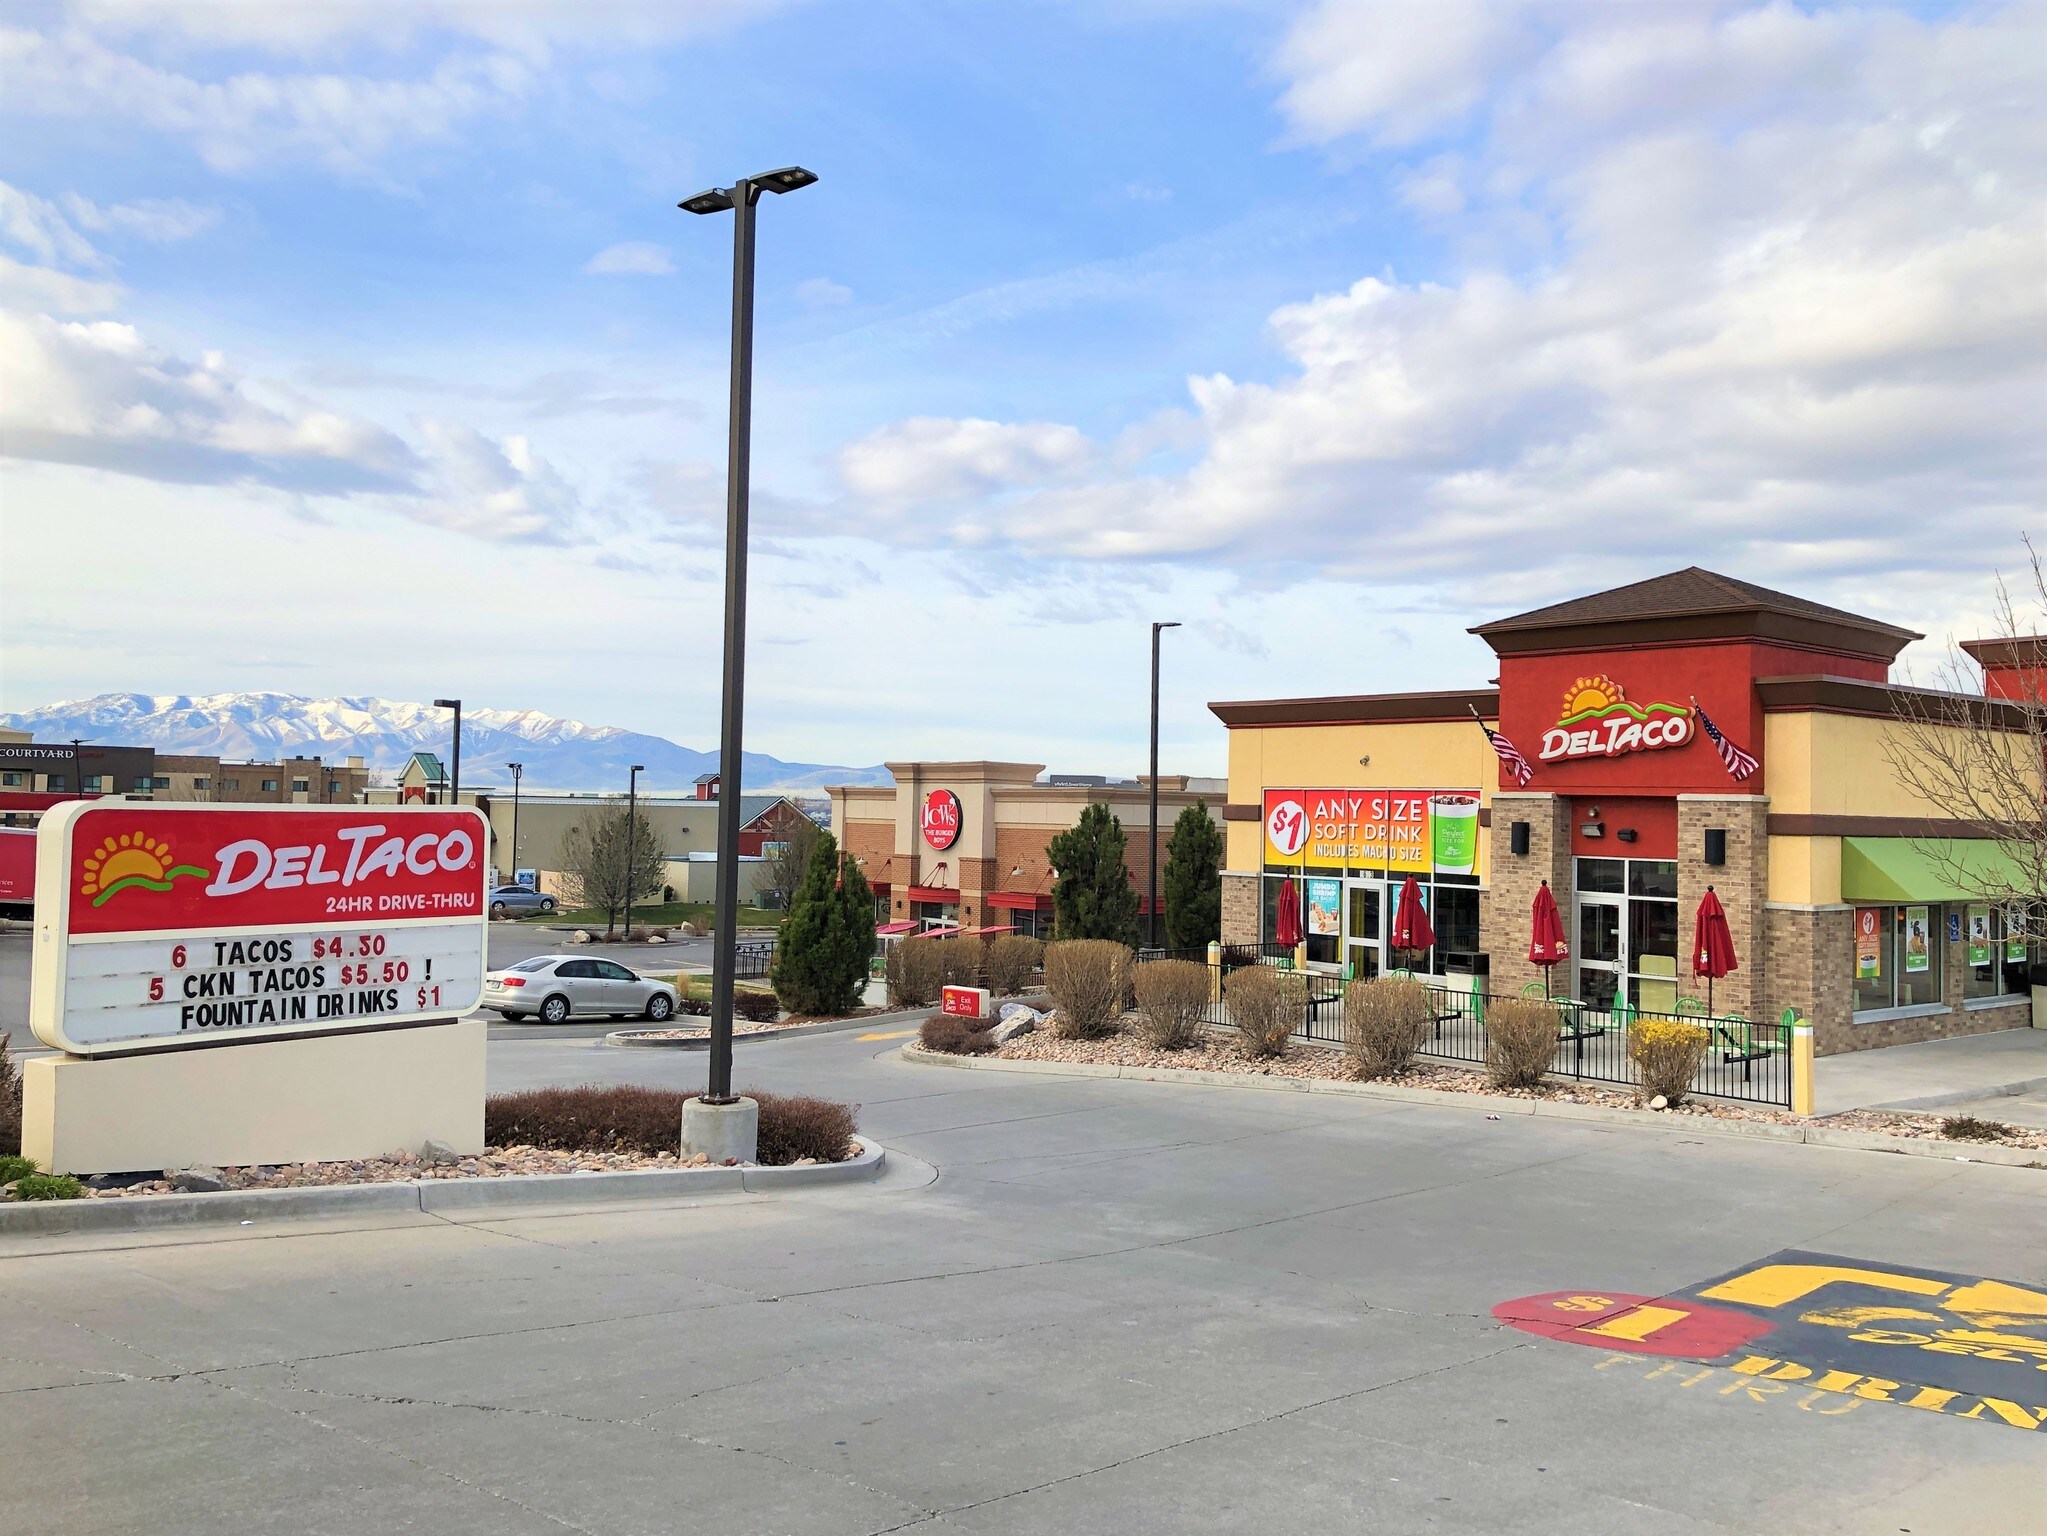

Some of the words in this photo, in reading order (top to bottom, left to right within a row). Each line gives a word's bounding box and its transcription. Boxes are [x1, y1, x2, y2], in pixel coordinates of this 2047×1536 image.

[1539, 729, 1606, 759] DEL
[1603, 717, 1687, 753] TACO
[0, 748, 74, 759] COURTYARD
[1314, 798, 1363, 820] ANY
[1371, 799, 1424, 822] SIZE
[1273, 807, 1303, 850] $1
[1314, 823, 1359, 840] SOFT
[1364, 824, 1424, 843] DRINK
[205, 839, 340, 898] DEL
[337, 824, 474, 888] TACO
[1400, 847, 1423, 862] SIZE
[1312, 882, 1336, 890] JUMBO
[1312, 889, 1336, 897] SHRIMP
[325, 896, 374, 913] 24HR
[378, 892, 476, 911] DRIVE-THRU
[172, 945, 186, 968] 6
[215, 940, 292, 966] TACOS
[150, 977, 164, 1001] 5
[183, 971, 234, 998] CKN
[249, 965, 325, 993] TACOS
[341, 961, 409, 985] $5.50
[182, 995, 306, 1029] FOUNTAIN
[317, 988, 398, 1018] DRINKS
[417, 986, 440, 1008] $1
[959, 1004, 972, 1014] Only
[960, 996, 972, 1004] Exit
